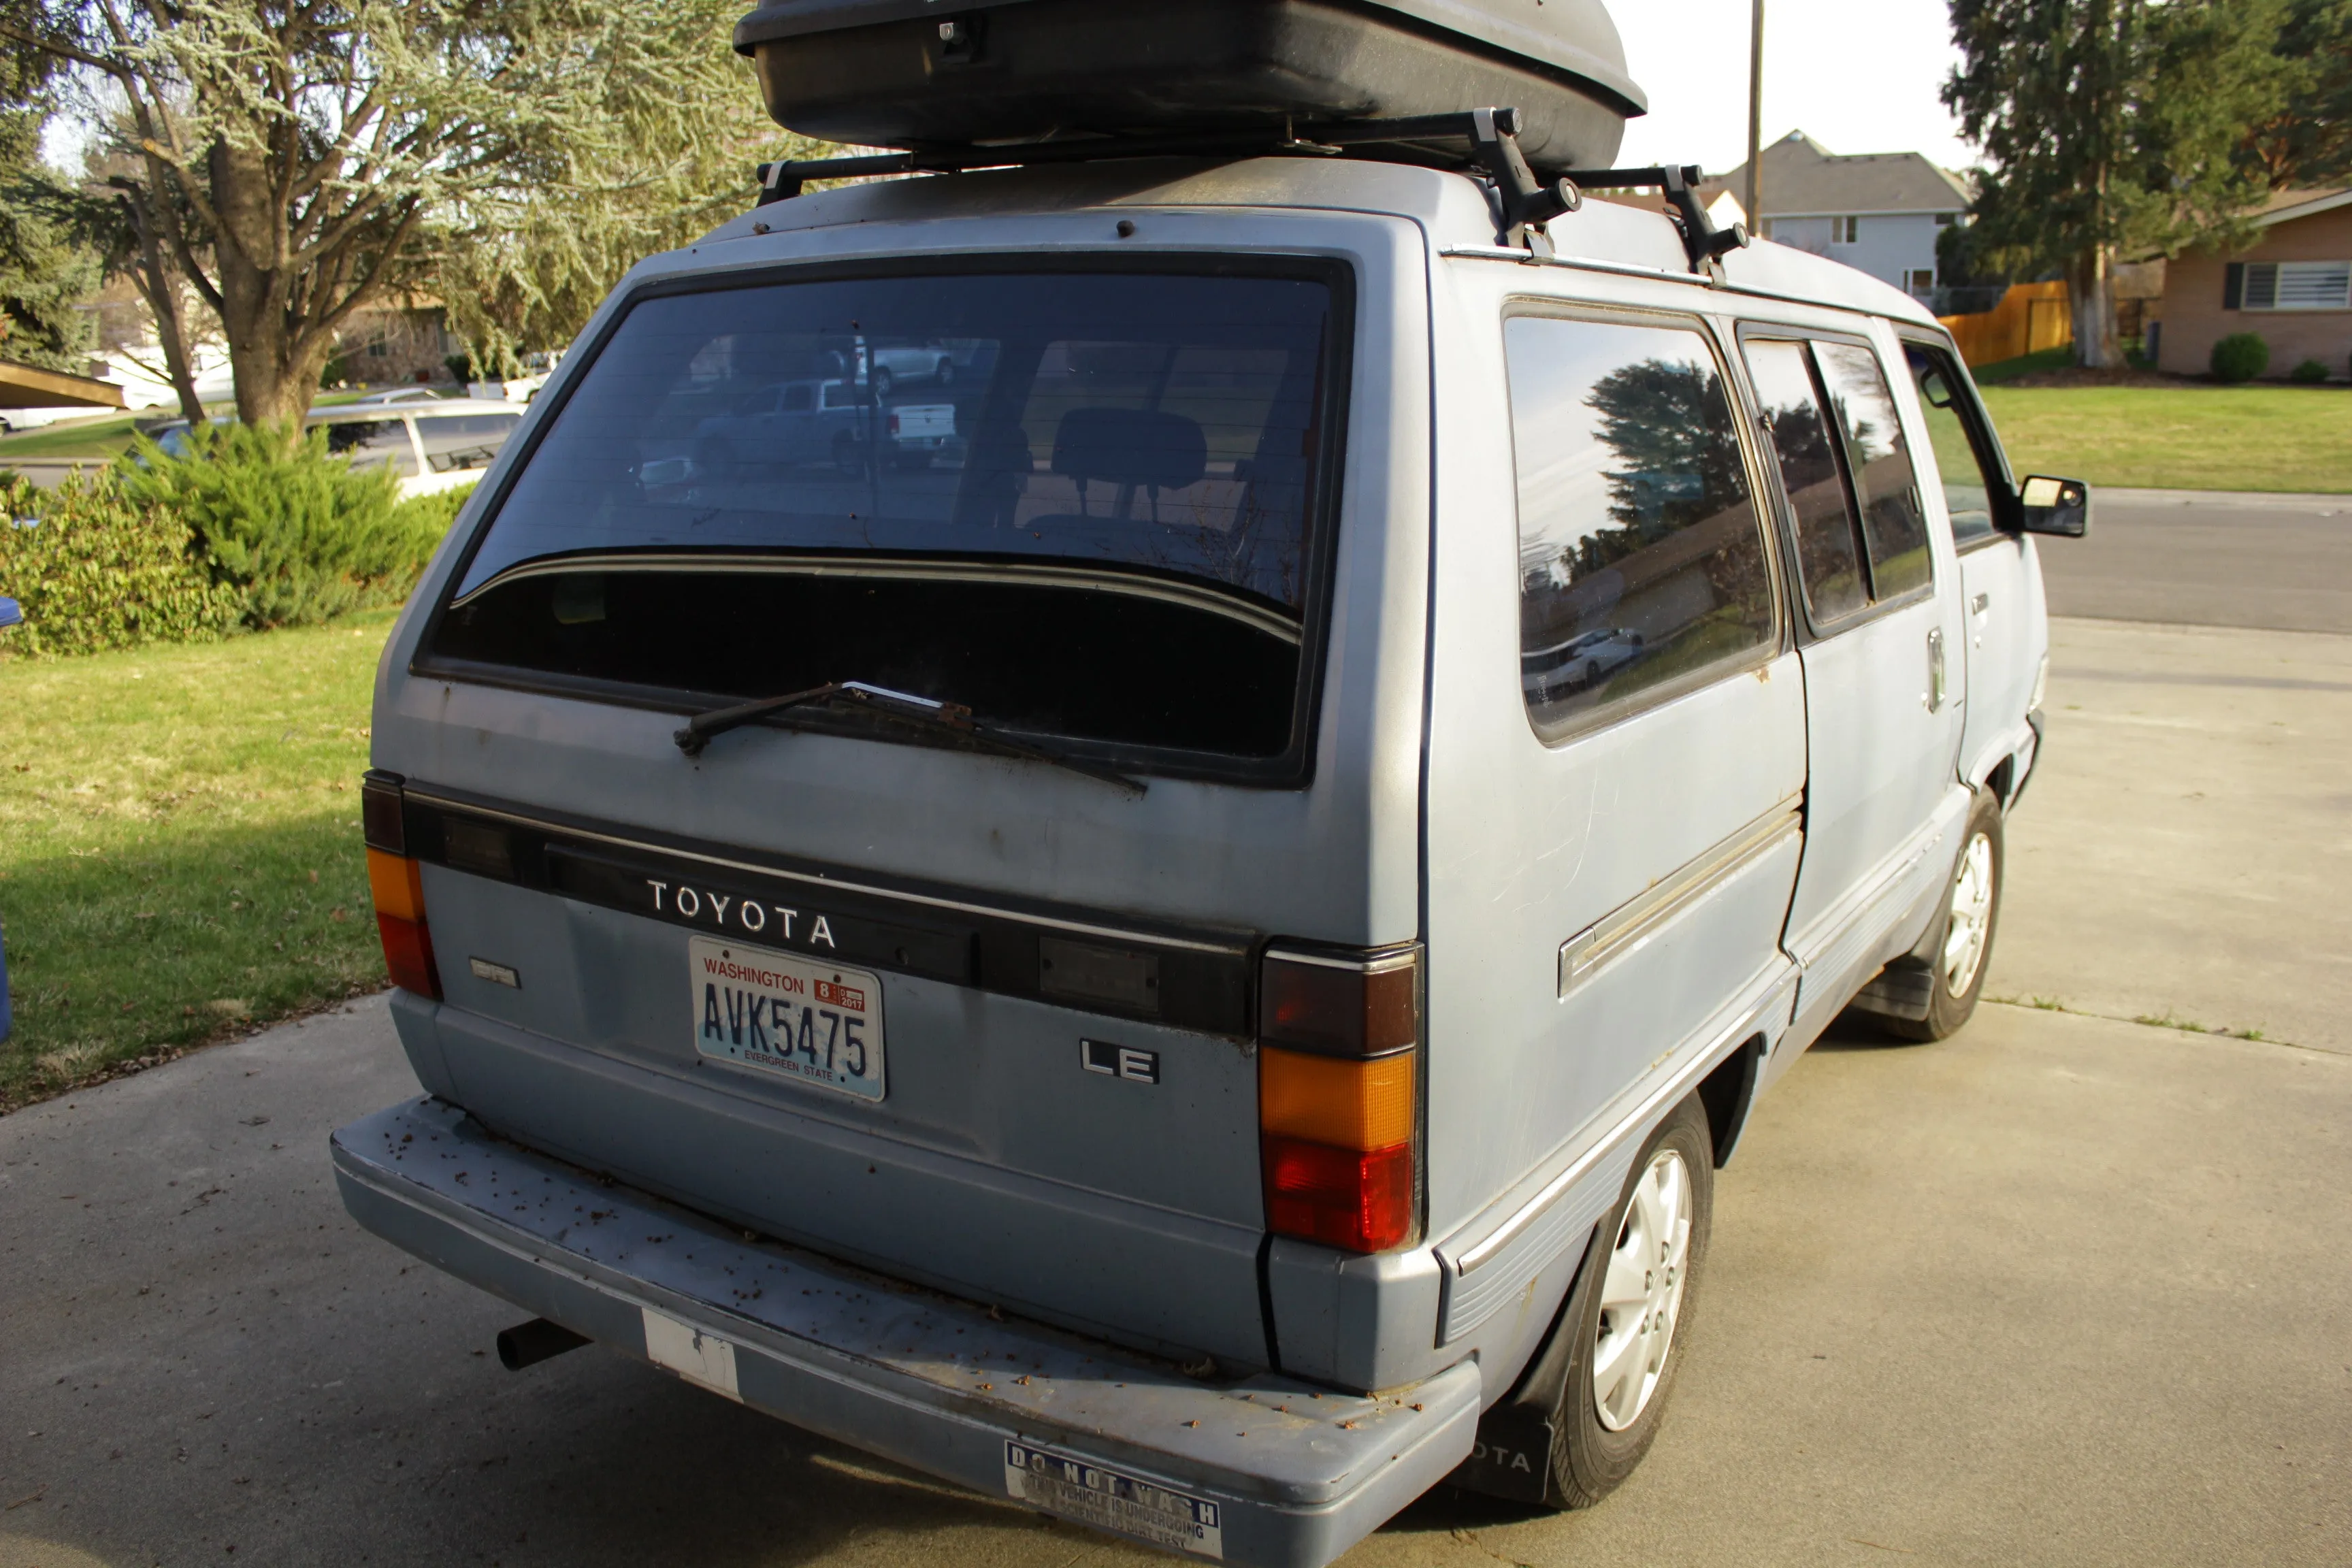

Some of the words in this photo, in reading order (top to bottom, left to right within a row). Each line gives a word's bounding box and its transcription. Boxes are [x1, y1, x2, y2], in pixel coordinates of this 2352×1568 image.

[647, 879, 835, 948] TOYOTA
[704, 957, 804, 994] WASHINGTON
[819, 983, 829, 998] 8
[841, 997, 862, 1009] 2017
[704, 983, 866, 1077] AVK5475
[745, 1050, 799, 1072] EVERGREEN
[804, 1065, 833, 1081] STATE
[1081, 1041, 1154, 1083] LE
[1012, 1446, 1045, 1473] DO
[1064, 1461, 1116, 1494] NOT
[1111, 1498, 1122, 1513] IS
